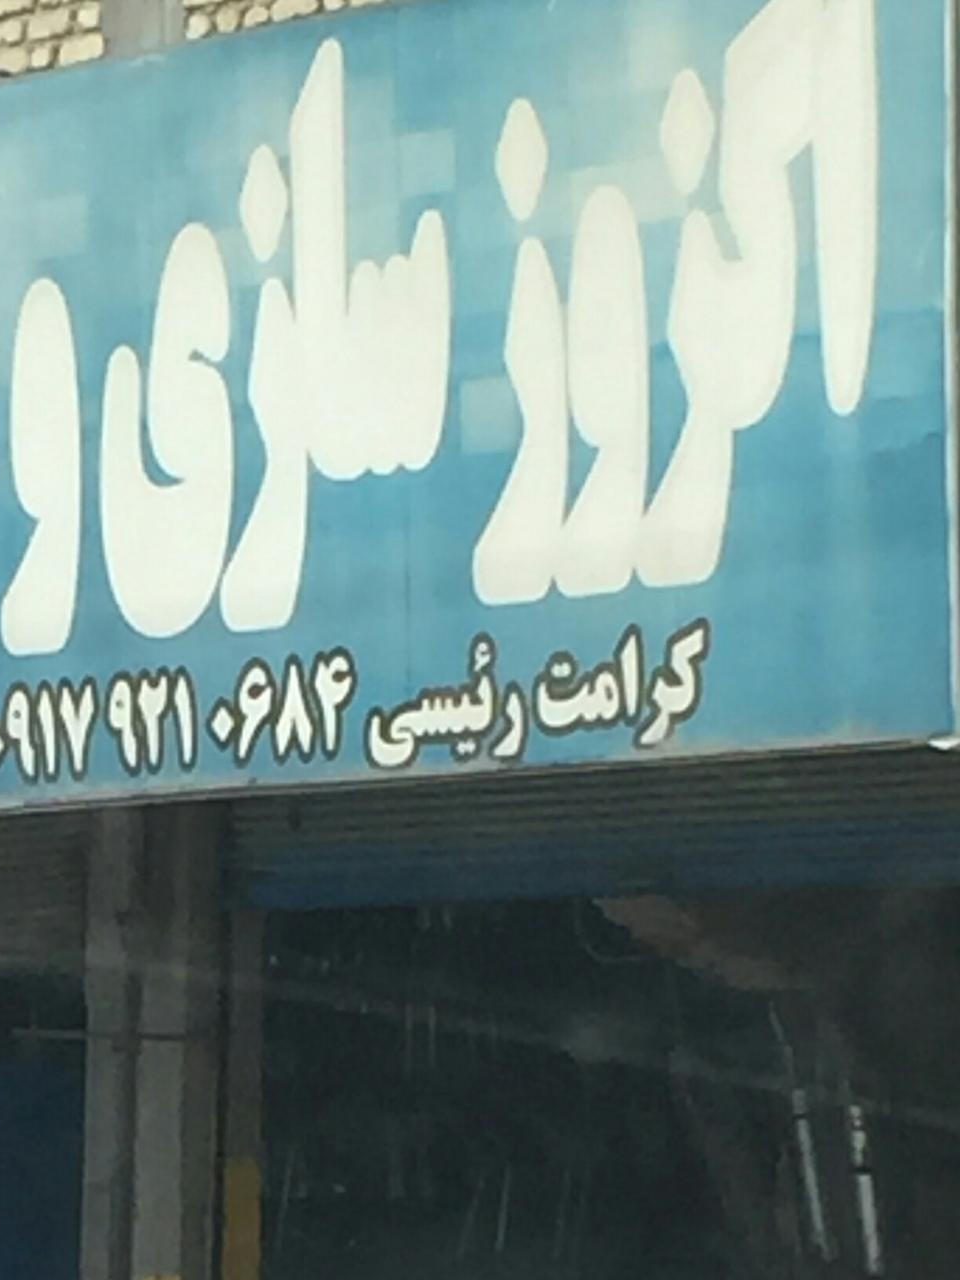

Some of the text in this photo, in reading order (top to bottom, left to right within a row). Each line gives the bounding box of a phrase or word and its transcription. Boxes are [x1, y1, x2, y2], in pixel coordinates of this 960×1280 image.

[100, 37, 451, 638] سازی
[0, 277, 82, 656] و
[208, 647, 356, 766] ۰۶۸۴
[366, 632, 527, 769] رئیسی
[536, 618, 708, 747] کرامت
